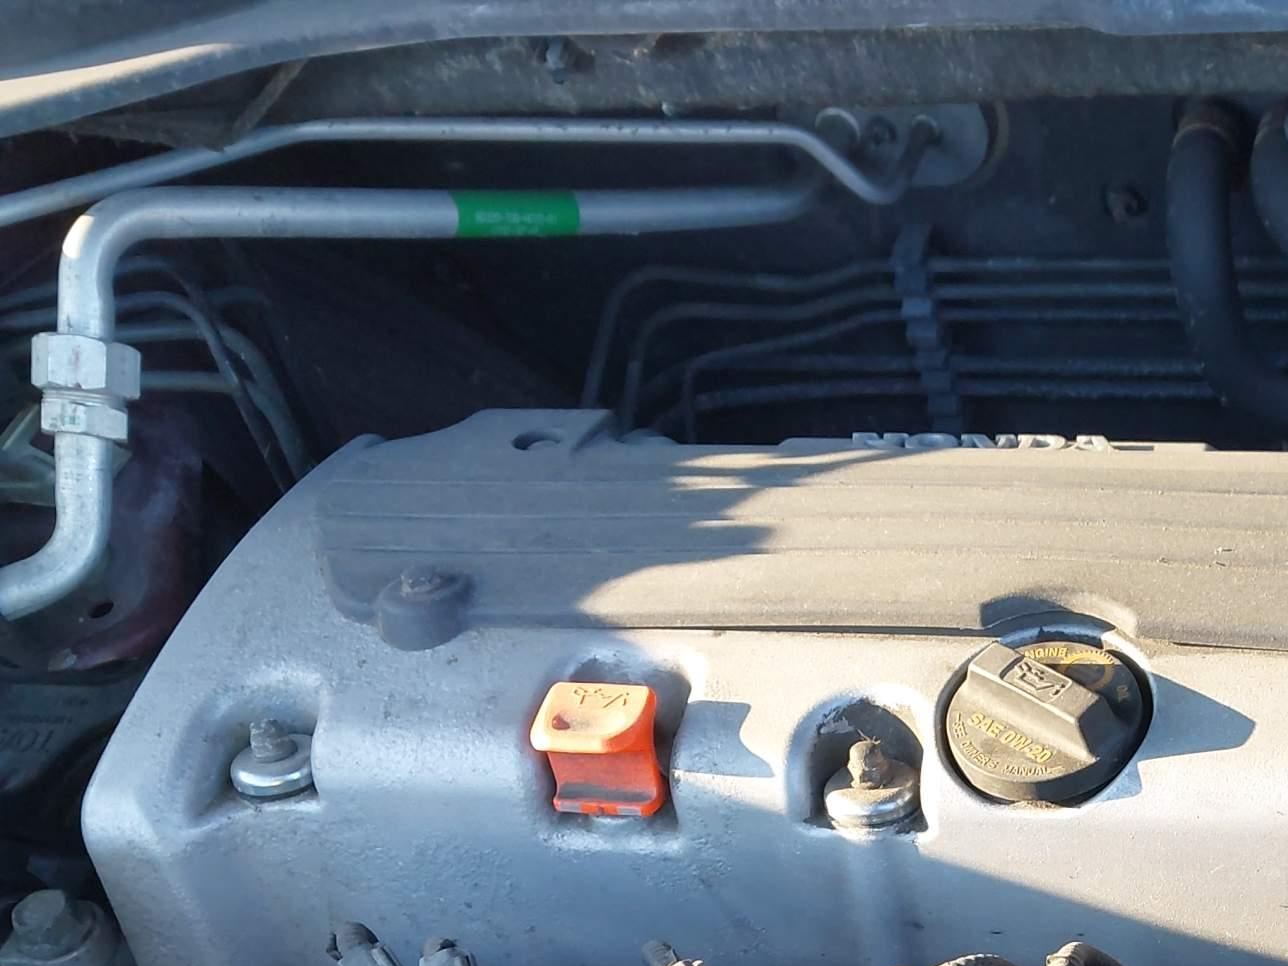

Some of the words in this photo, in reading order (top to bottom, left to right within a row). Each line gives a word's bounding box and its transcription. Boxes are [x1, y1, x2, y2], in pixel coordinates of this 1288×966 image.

[852, 432, 1119, 451] HONDA
[1024, 647, 1068, 658] NGINE
[967, 711, 1003, 738] SAE
